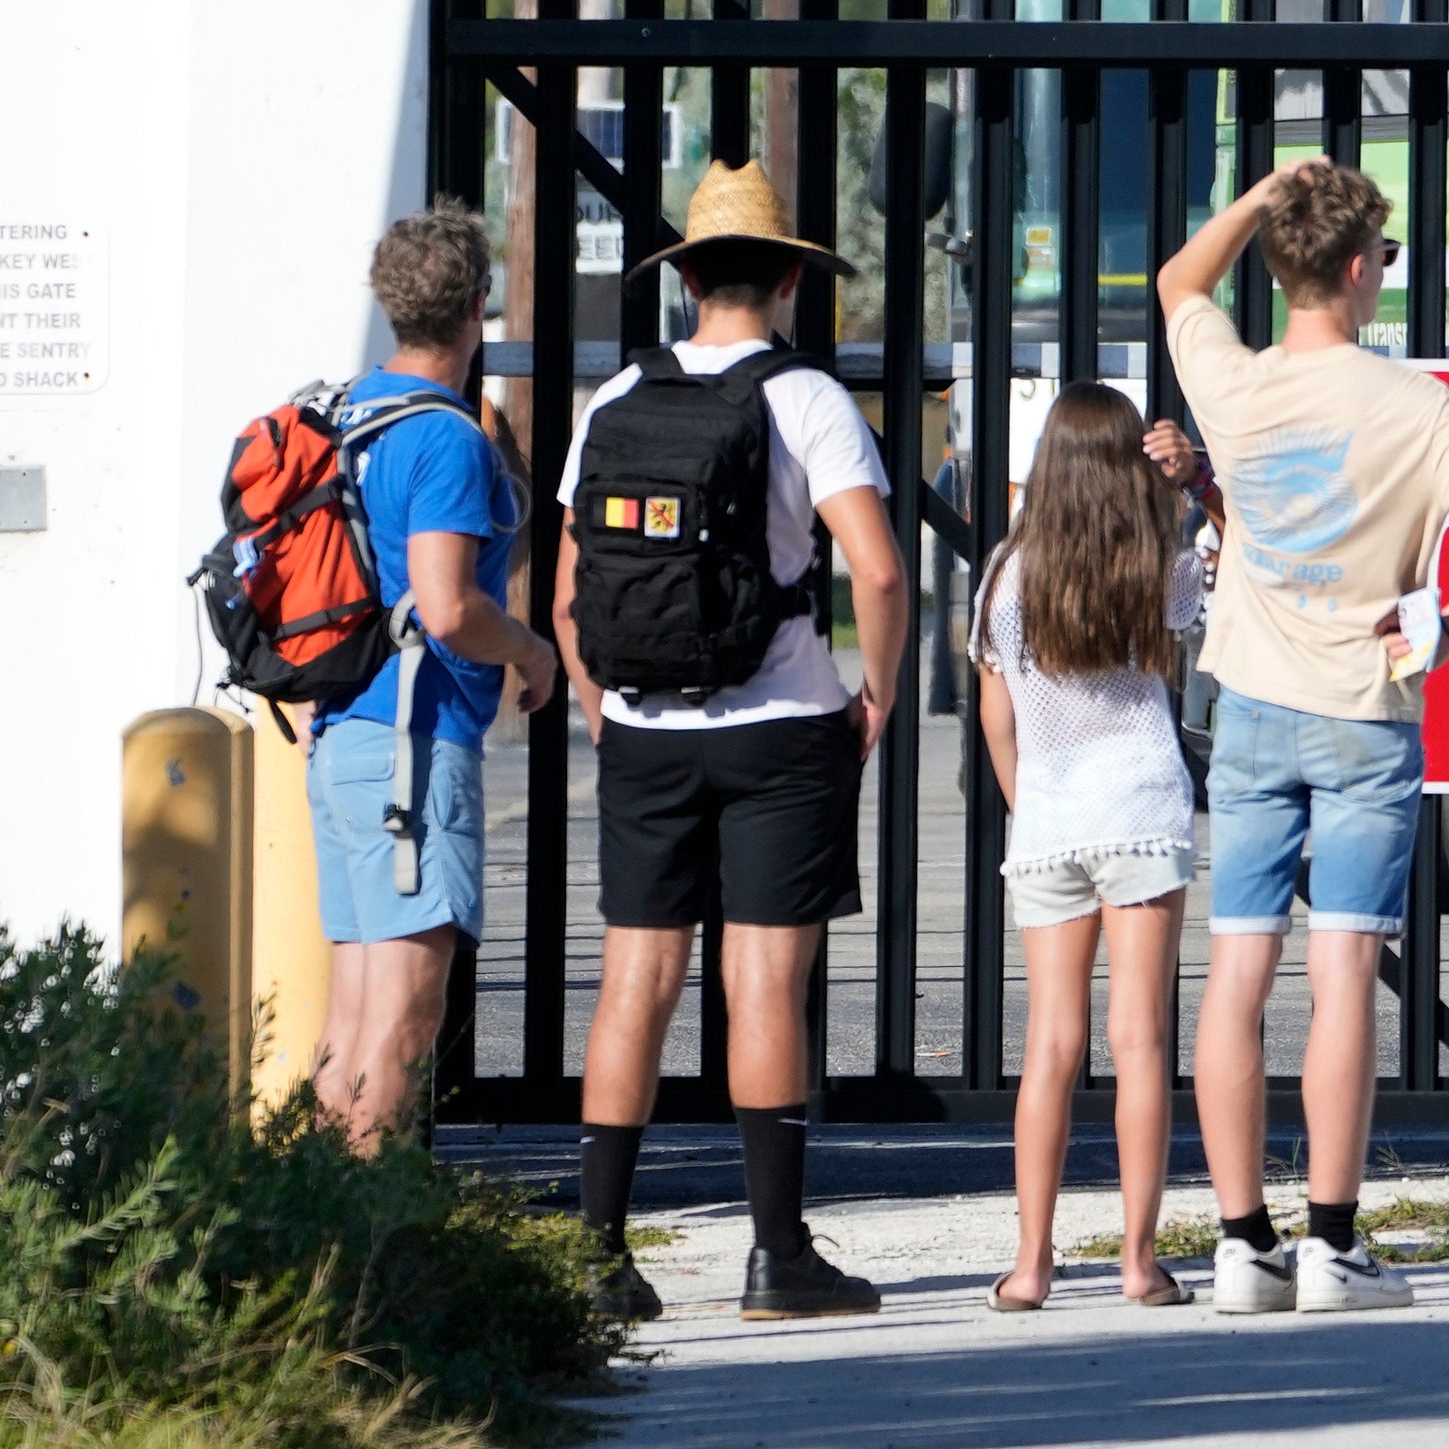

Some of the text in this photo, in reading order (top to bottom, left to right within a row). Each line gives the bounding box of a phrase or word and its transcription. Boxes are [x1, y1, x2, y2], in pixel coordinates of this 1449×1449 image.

[27, 283, 77, 299] GATE
[24, 312, 81, 329] THEIR
[17, 342, 93, 359] SENTRY
[14, 371, 79, 388] SHACK
